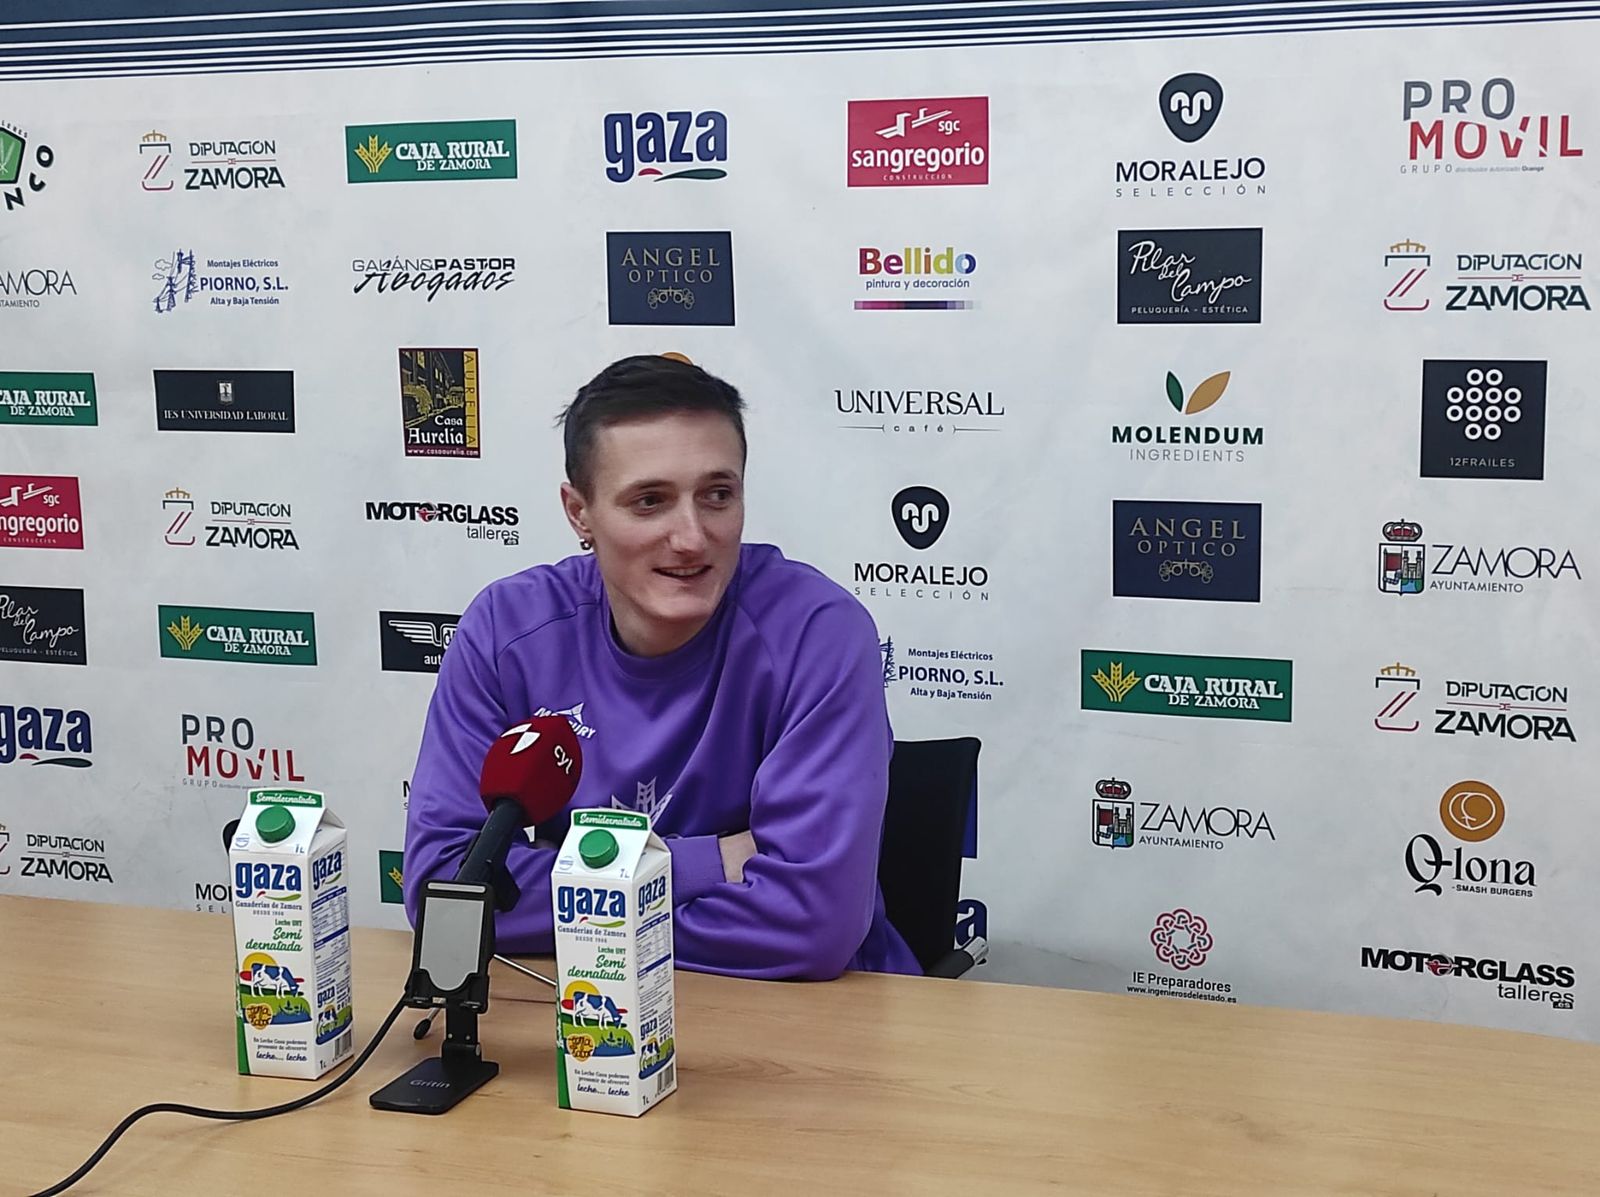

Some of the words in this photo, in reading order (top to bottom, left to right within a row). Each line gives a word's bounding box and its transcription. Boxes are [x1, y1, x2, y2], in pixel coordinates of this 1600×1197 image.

[1403, 78, 1515, 121] PRO
[938, 120, 960, 135] sgc
[395, 142, 443, 161] CAJA
[446, 140, 510, 159] RURAL
[604, 110, 728, 183] gaza
[416, 160, 435, 171] DE
[439, 158, 492, 170] ZAMORA
[851, 142, 985, 173] sangregorio
[1116, 157, 1266, 182] MORALEJO
[1400, 164, 1453, 174] GRUPO
[184, 167, 285, 190] ZAMORA
[1116, 184, 1266, 198] SELECCIÓN
[207, 259, 240, 270] Montajes
[242, 258, 279, 268] Eléctricos
[352, 256, 515, 272] GALÁN&PASTOR
[621, 247, 720, 266] ANGEL
[859, 247, 977, 275] Bellido
[1128, 240, 1196, 275] Pilar
[628, 269, 713, 283] OPTICO
[1158, 262, 1183, 281] del
[200, 277, 260, 293] PIORNO,
[263, 276, 288, 290] S.L.
[353, 260, 515, 302] Abogados
[865, 279, 901, 291] pintura
[904, 280, 910, 290] y
[912, 278, 970, 288] decoración
[1171, 268, 1252, 304] Campo
[0, 300, 40, 308] TAMIENTO
[210, 297, 225, 306] Alta
[226, 298, 232, 307] y
[232, 296, 249, 307] Baja
[250, 296, 280, 305] Tensión
[1445, 284, 1592, 311] ZAMORA
[1131, 305, 1190, 314] PELUQUERÍA
[1202, 303, 1248, 314] ESTÉTICA
[34, 390, 91, 406] RURAL
[834, 389, 1005, 416] UNIVERSAL
[10, 405, 26, 416] DE
[28, 406, 75, 416] ZAMORA
[164, 410, 179, 420] IES
[181, 410, 244, 421] UNIVERSIDAD
[246, 410, 288, 421] LABORAL
[434, 415, 463, 426] Casa
[407, 428, 464, 445] Aurelia
[1112, 426, 1264, 445] MOLENDUM
[1130, 449, 1245, 462] INGREDIENTS
[1450, 457, 1516, 468] 12FRAILES
[43, 494, 60, 506] sgc
[366, 502, 519, 526] MOTORGLASS
[467, 526, 519, 540] talleres
[1129, 517, 1246, 539] ANGEL
[205, 526, 300, 550] ZAMORA
[1138, 540, 1236, 557] OPTICO
[1432, 544, 1582, 580] ZAMORA
[854, 563, 988, 586] MORALEJO
[855, 587, 989, 601] SELECCIÓN
[1430, 581, 1524, 593] AYUNTAMIENTO
[23, 618, 79, 648] Campo
[206, 626, 246, 644] CAJA
[249, 627, 309, 646] RURAL
[224, 642, 240, 654] DE
[243, 644, 292, 656] ZAMORA
[908, 648, 949, 660] Montajes
[950, 650, 993, 661] Eléctricos
[899, 666, 969, 686] PIORNO,
[974, 670, 1004, 686] S.L.
[910, 688, 928, 696] Alta
[929, 690, 936, 698] y
[937, 690, 956, 700] Baja
[956, 690, 992, 700] Tensión
[1144, 674, 1200, 695] CAJA
[1204, 677, 1284, 699] RURAL
[1168, 694, 1189, 706] DE
[1194, 696, 1260, 710] ZAMORA
[182, 714, 254, 750] PRO
[1434, 710, 1577, 742] ZAMORA
[182, 778, 218, 788] GRUPO
[1140, 802, 1276, 841] ZAMORA
[1138, 836, 1224, 850] AYUNTAMIENTO
[20, 857, 114, 884] ZAMORA
[312, 850, 342, 890] gaza
[235, 862, 302, 898] gaza
[638, 876, 666, 916] gaza
[1490, 886, 1534, 898] BURGERS
[558, 886, 626, 924] gaza
[273, 927, 303, 940] Semi
[245, 938, 304, 952] desnatada
[596, 954, 626, 968] Semi
[1361, 947, 1575, 988] MOTORGLASS
[568, 966, 626, 981] desnatada
[1132, 971, 1144, 984] IE
[1148, 973, 1232, 993] Preparadores
[317, 986, 335, 1008] gaza
[1126, 986, 1237, 1004] www.ingenierosdelestado.es
[1498, 984, 1574, 1003] talleres
[640, 1018, 658, 1040] gaza
[410, 1079, 450, 1088] Gritin
